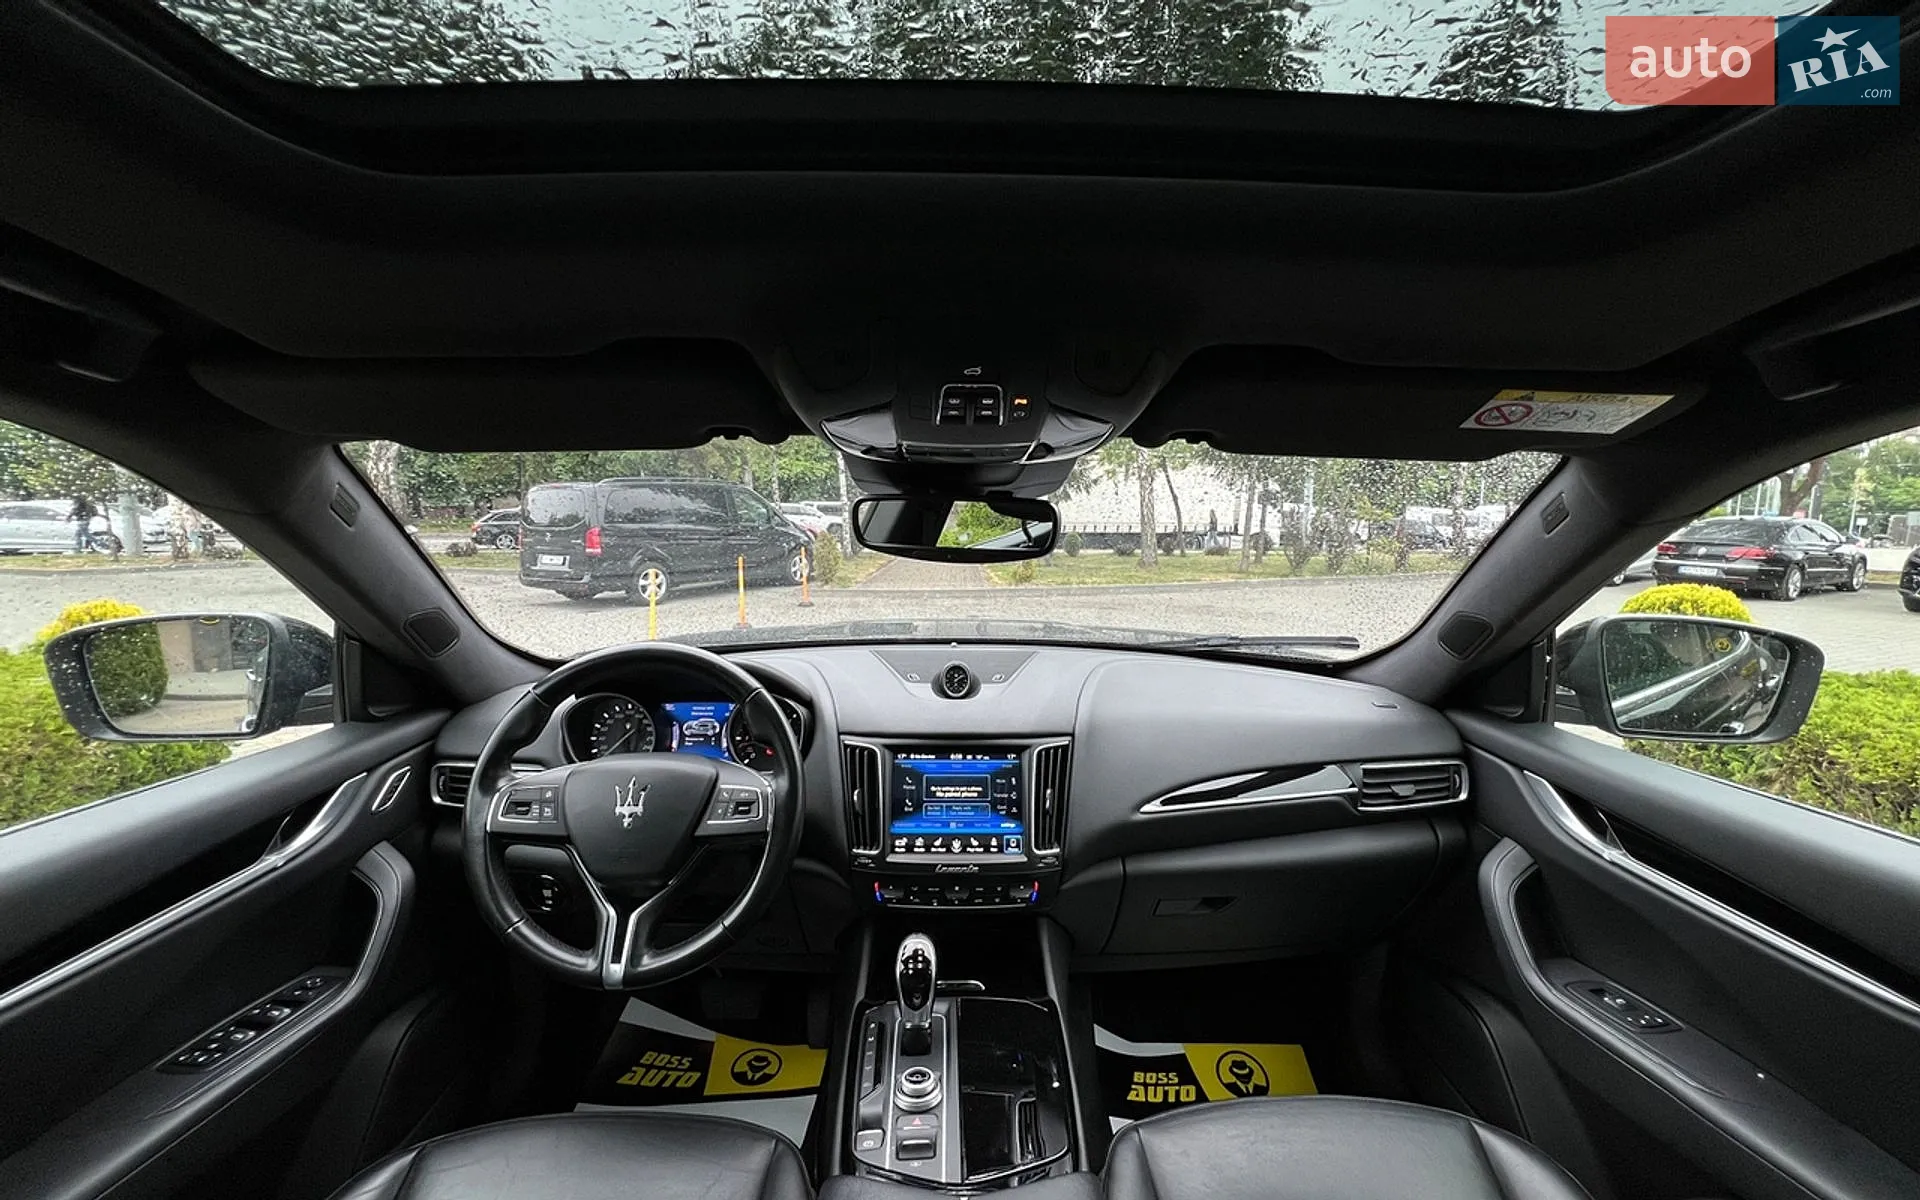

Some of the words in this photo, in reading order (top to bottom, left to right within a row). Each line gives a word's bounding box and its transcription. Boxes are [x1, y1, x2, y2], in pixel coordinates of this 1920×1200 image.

[640, 1051, 693, 1068] BOSS
[616, 1067, 701, 1087] AUTO
[1133, 1071, 1179, 1084] BOSS
[1126, 1084, 1196, 1102] AUTO
